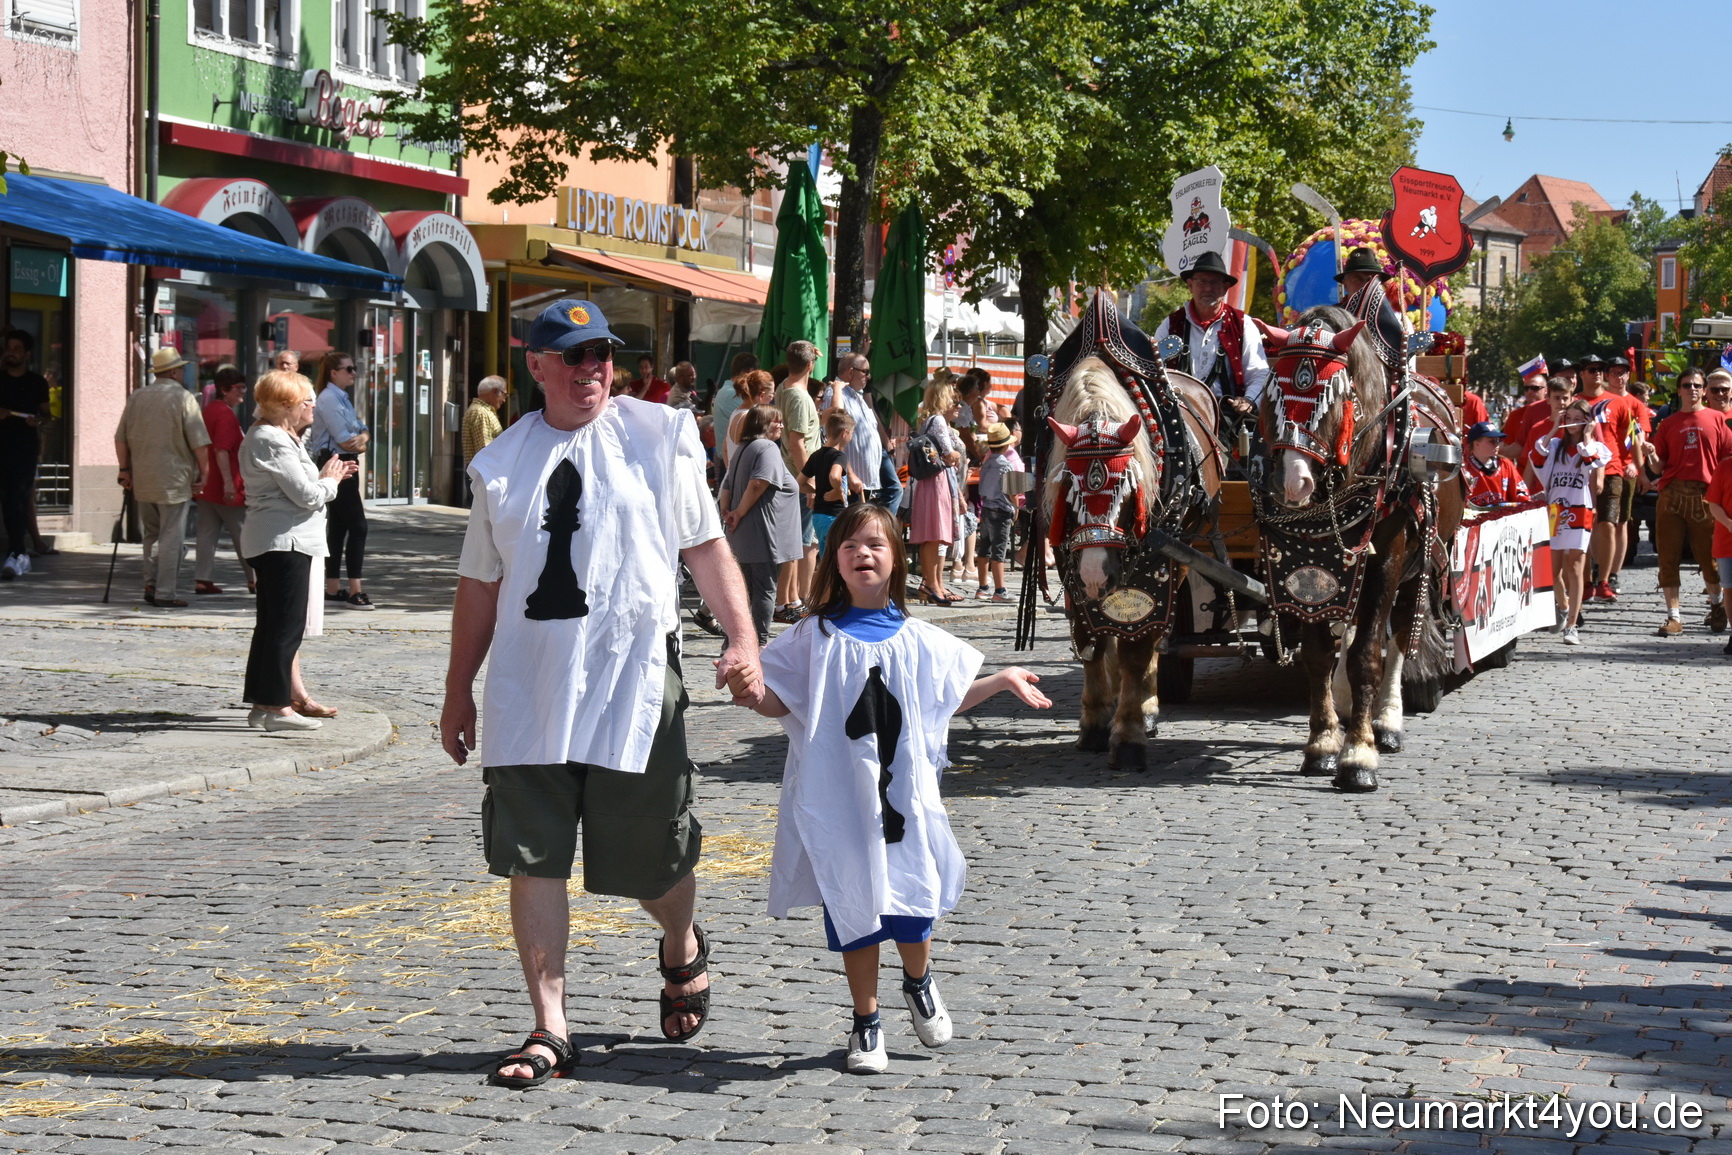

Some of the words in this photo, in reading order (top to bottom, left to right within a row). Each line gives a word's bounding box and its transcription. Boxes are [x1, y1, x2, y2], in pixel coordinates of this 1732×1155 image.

[1399, 175, 1456, 193] Eissportfreunde
[1403, 186, 1438, 199] Neumarkt
[567, 185, 616, 236] LEDER
[324, 205, 380, 237] Metzgerei
[1183, 232, 1208, 252] EAGLES
[1420, 248, 1435, 257] 1999
[14, 260, 39, 286] Essig
[47, 259, 59, 283] Öl
